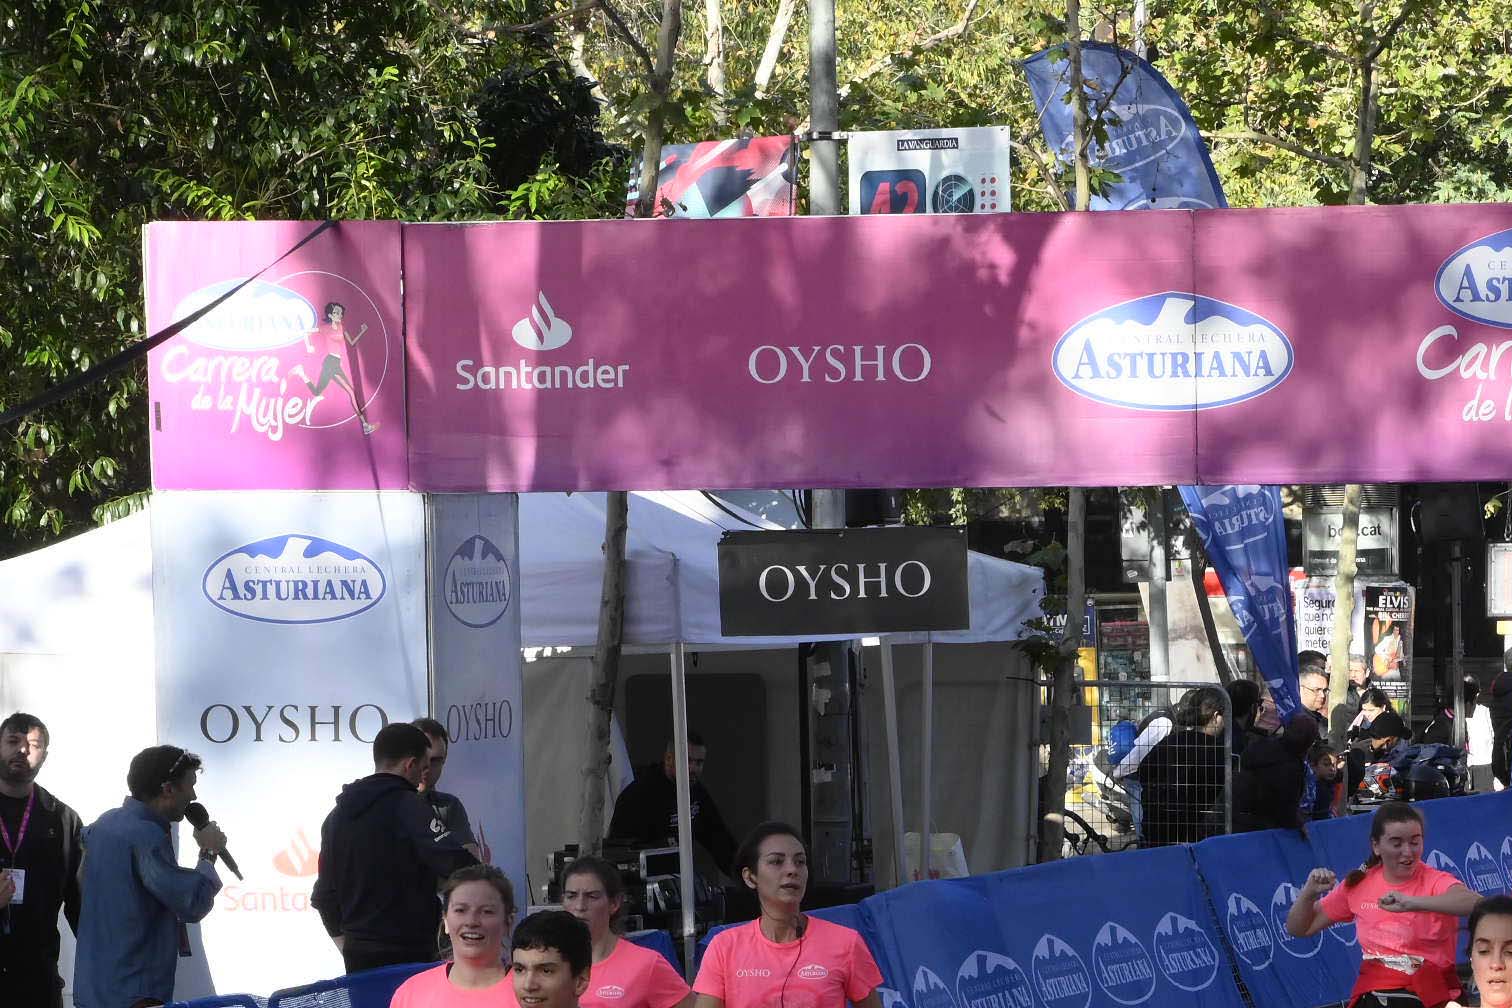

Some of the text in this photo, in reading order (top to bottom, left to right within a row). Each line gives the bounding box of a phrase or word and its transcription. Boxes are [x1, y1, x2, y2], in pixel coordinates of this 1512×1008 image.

[1191, 330, 1267, 345] LECHERA
[161, 345, 279, 382] Carrera
[456, 359, 629, 390] Santander
[749, 343, 932, 386] OYSHO
[1072, 337, 1272, 380] ASTURIANA
[192, 384, 211, 410] de
[230, 379, 325, 441] Mujer
[1462, 384, 1494, 422] de
[217, 568, 372, 600] ASTURIANA
[245, 566, 366, 576] CENTRAL LECHERA
[449, 571, 507, 605] ASTURIANA
[759, 559, 931, 603] OYSHO
[1379, 595, 1409, 608] ELVIS
[200, 704, 389, 743] OYSHO
[446, 699, 513, 745] OYSHO
[223, 886, 310, 912] Santa
[736, 968, 770, 978] OYSHO
